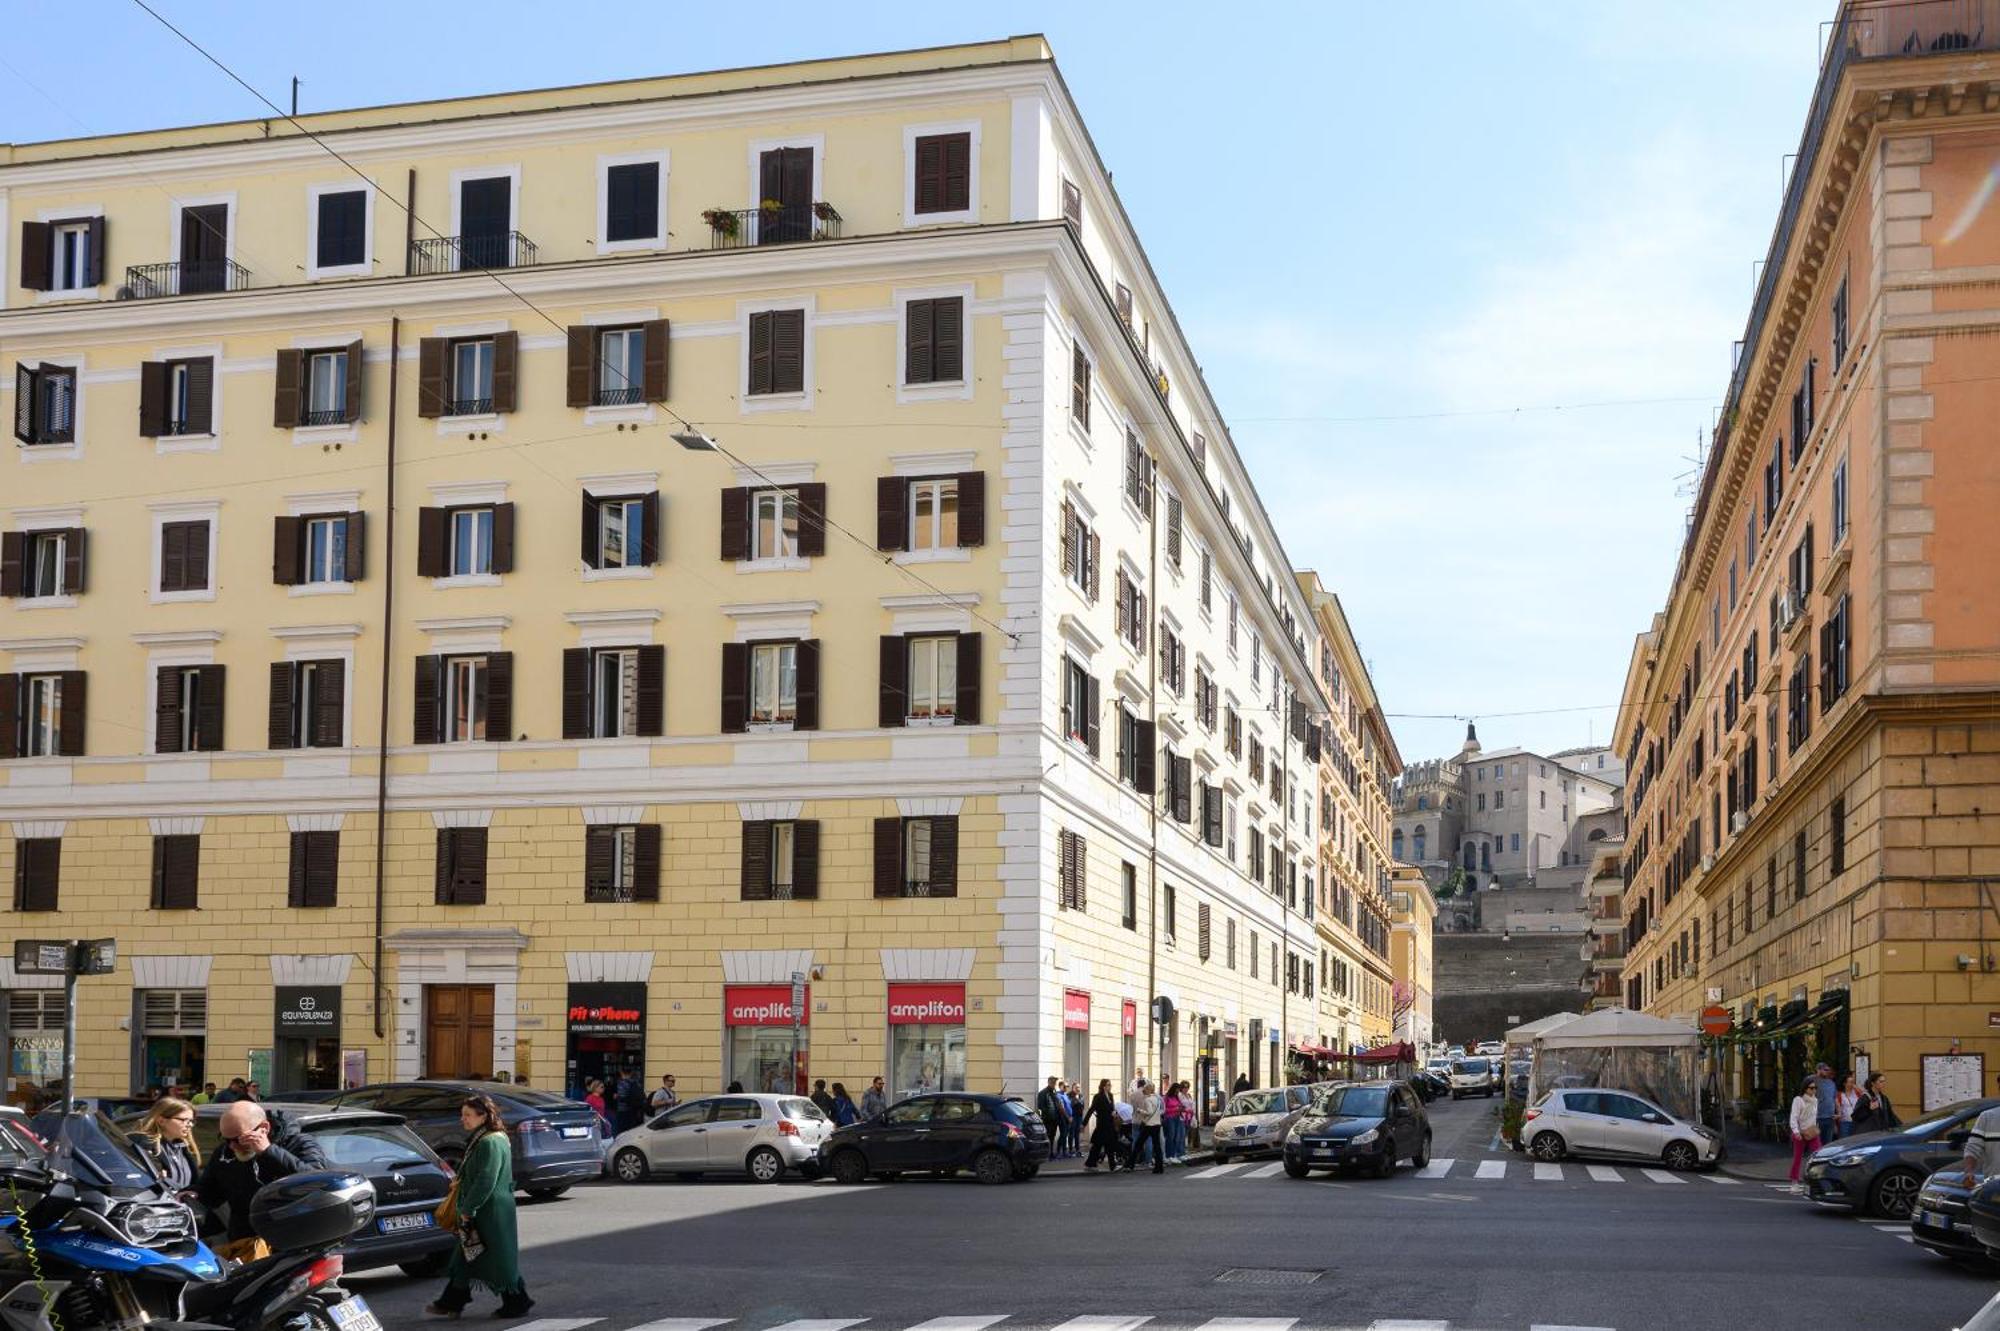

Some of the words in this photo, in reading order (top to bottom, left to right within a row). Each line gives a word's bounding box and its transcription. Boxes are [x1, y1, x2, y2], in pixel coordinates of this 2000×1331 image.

[569, 1006, 588, 1020] Pit
[599, 1006, 640, 1020] Phone
[733, 1002, 792, 1022] amplifo
[890, 1001, 964, 1020] amplifon
